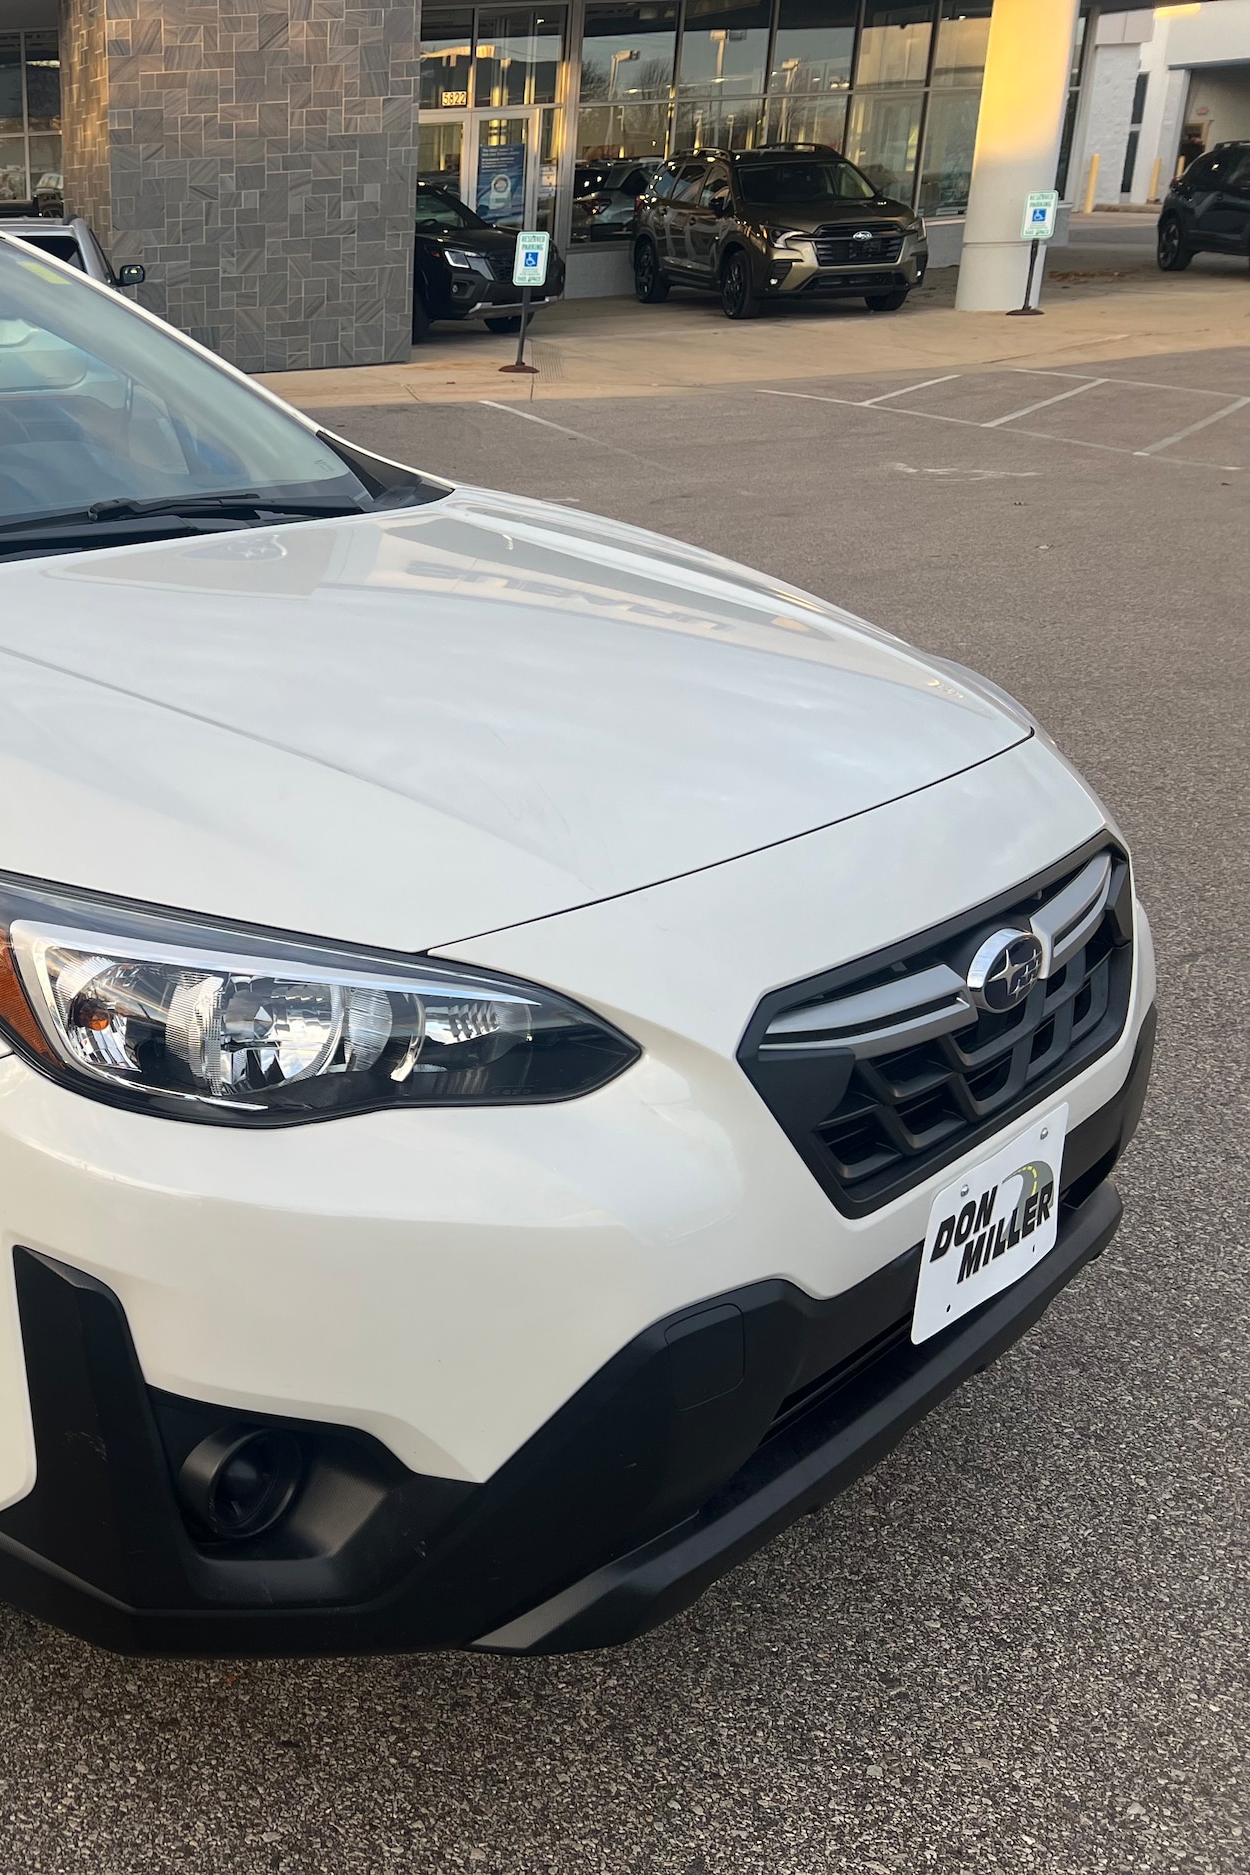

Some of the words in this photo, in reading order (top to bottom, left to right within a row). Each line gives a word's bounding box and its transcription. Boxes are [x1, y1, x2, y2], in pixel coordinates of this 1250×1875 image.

[443, 92, 466, 105] 5822
[930, 1185, 998, 1263] DON
[957, 1181, 1054, 1285] MILLER
